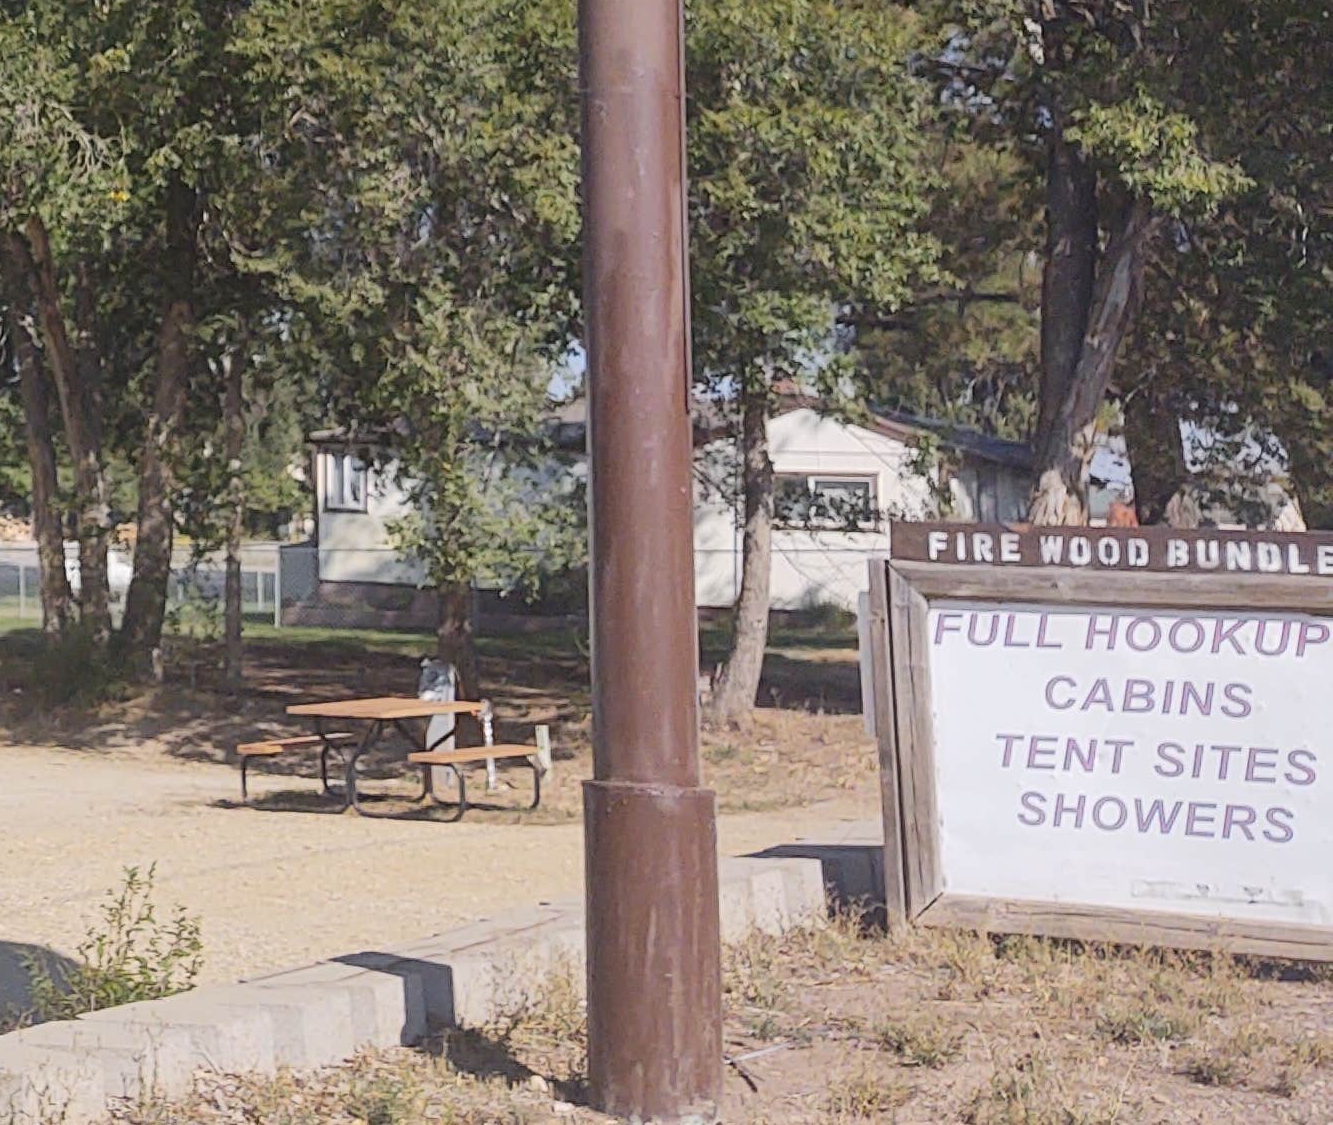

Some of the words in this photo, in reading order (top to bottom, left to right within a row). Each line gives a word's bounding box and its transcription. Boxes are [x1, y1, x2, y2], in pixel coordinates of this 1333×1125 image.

[929, 531, 1021, 562] FIRE
[1039, 534, 1151, 567] WOOD
[1167, 539, 1333, 574] BUNDLE
[934, 612, 1063, 649] FULL
[1085, 614, 1332, 657] HOOKUP
[1044, 676, 1253, 718] CABINS
[996, 733, 1135, 774] TENT
[1153, 742, 1318, 786] SITES
[1017, 791, 1295, 843] SHOWERS
